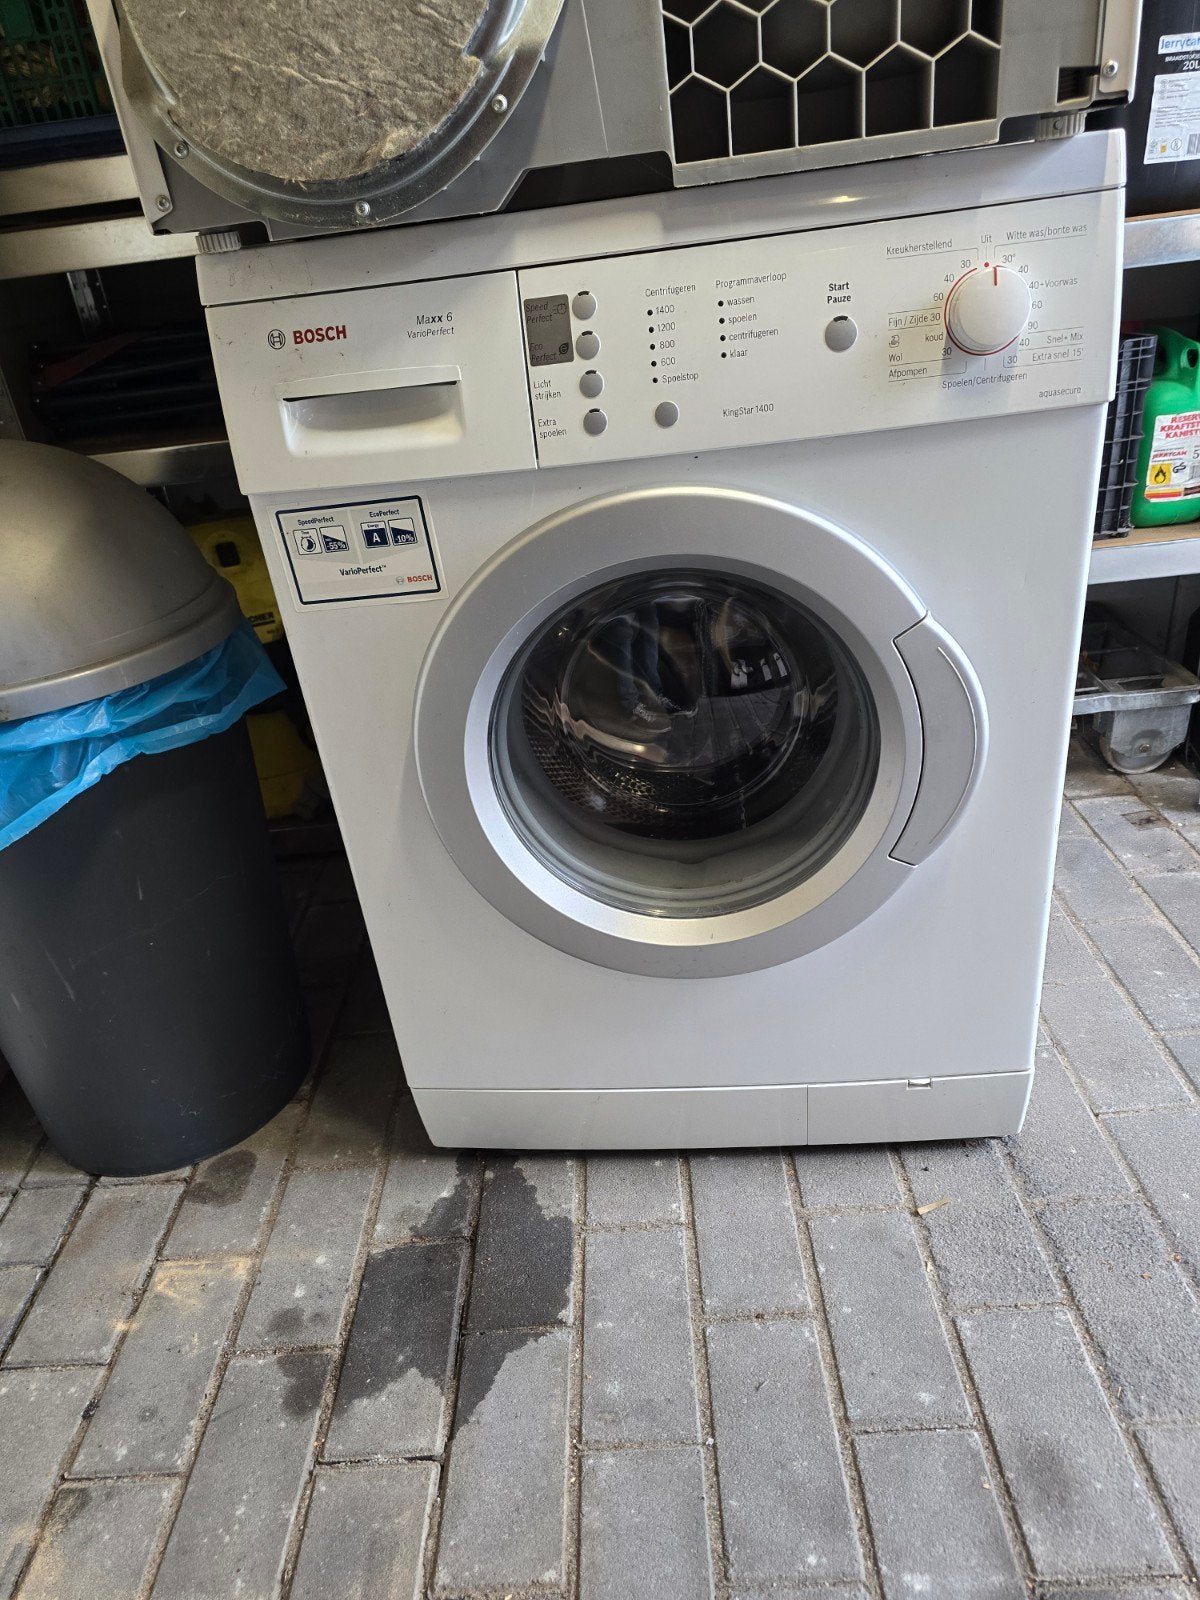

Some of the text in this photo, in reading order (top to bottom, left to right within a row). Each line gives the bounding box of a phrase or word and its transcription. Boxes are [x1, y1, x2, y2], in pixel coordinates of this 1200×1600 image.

[1006, 224, 1088, 241] Witte was/bonte was
[981, 234, 992, 244] Uit
[886, 239, 953, 256] Kreukherstellend
[960, 259, 971, 269] 30
[1018, 264, 1029, 274] 40
[716, 272, 787, 289] Programmaverloop
[943, 274, 955, 283] 40
[644, 283, 697, 298] Centrifugeren
[828, 281, 850, 292] Start
[727, 296, 755, 306] wassen
[826, 294, 852, 305] Pauze
[933, 292, 944, 302] 60
[525, 302, 549, 313] Speed
[655, 304, 676, 315] 1400
[1031, 300, 1043, 310] 60
[416, 311, 453, 325] Maxx 6
[526, 313, 553, 325] Perfect
[728, 312, 758, 325] spoelen
[888, 316, 903, 328] Fijn
[909, 313, 929, 326] Zijde
[930, 312, 941, 322] 30
[656, 321, 677, 333] 1200
[1027, 320, 1039, 331] 90
[293, 325, 347, 344] BOSCH
[406, 326, 455, 339] VarioPerfect
[728, 328, 779, 342] centrifugeren
[924, 332, 944, 342] koud
[529, 343, 543, 352] Eco
[659, 339, 676, 350] 800
[1019, 337, 1030, 347] 40
[729, 349, 749, 359] klaar
[888, 352, 903, 362] Wol
[942, 346, 953, 357] 30
[1032, 351, 1052, 362] Extra
[1053, 348, 1070, 359] snel
[531, 353, 558, 363] Perfect
[660, 356, 677, 367] 600
[1007, 355, 1018, 365] 30
[661, 371, 700, 385] Spoelstop
[888, 367, 928, 379] Afpompen
[533, 379, 552, 390] Licht
[942, 371, 1028, 390] Spoelen/Centrifugeren
[534, 389, 562, 401] strijken
[1038, 386, 1082, 398] aquasecure
[722, 403, 775, 418] KingStar 1400
[538, 418, 557, 428] Extra
[539, 428, 567, 440] spoelen
[368, 508, 400, 519] EcoPerfect
[297, 516, 335, 527] SpeedPerfect
[372, 532, 381, 544] A
[406, 574, 433, 584] BOSCH
